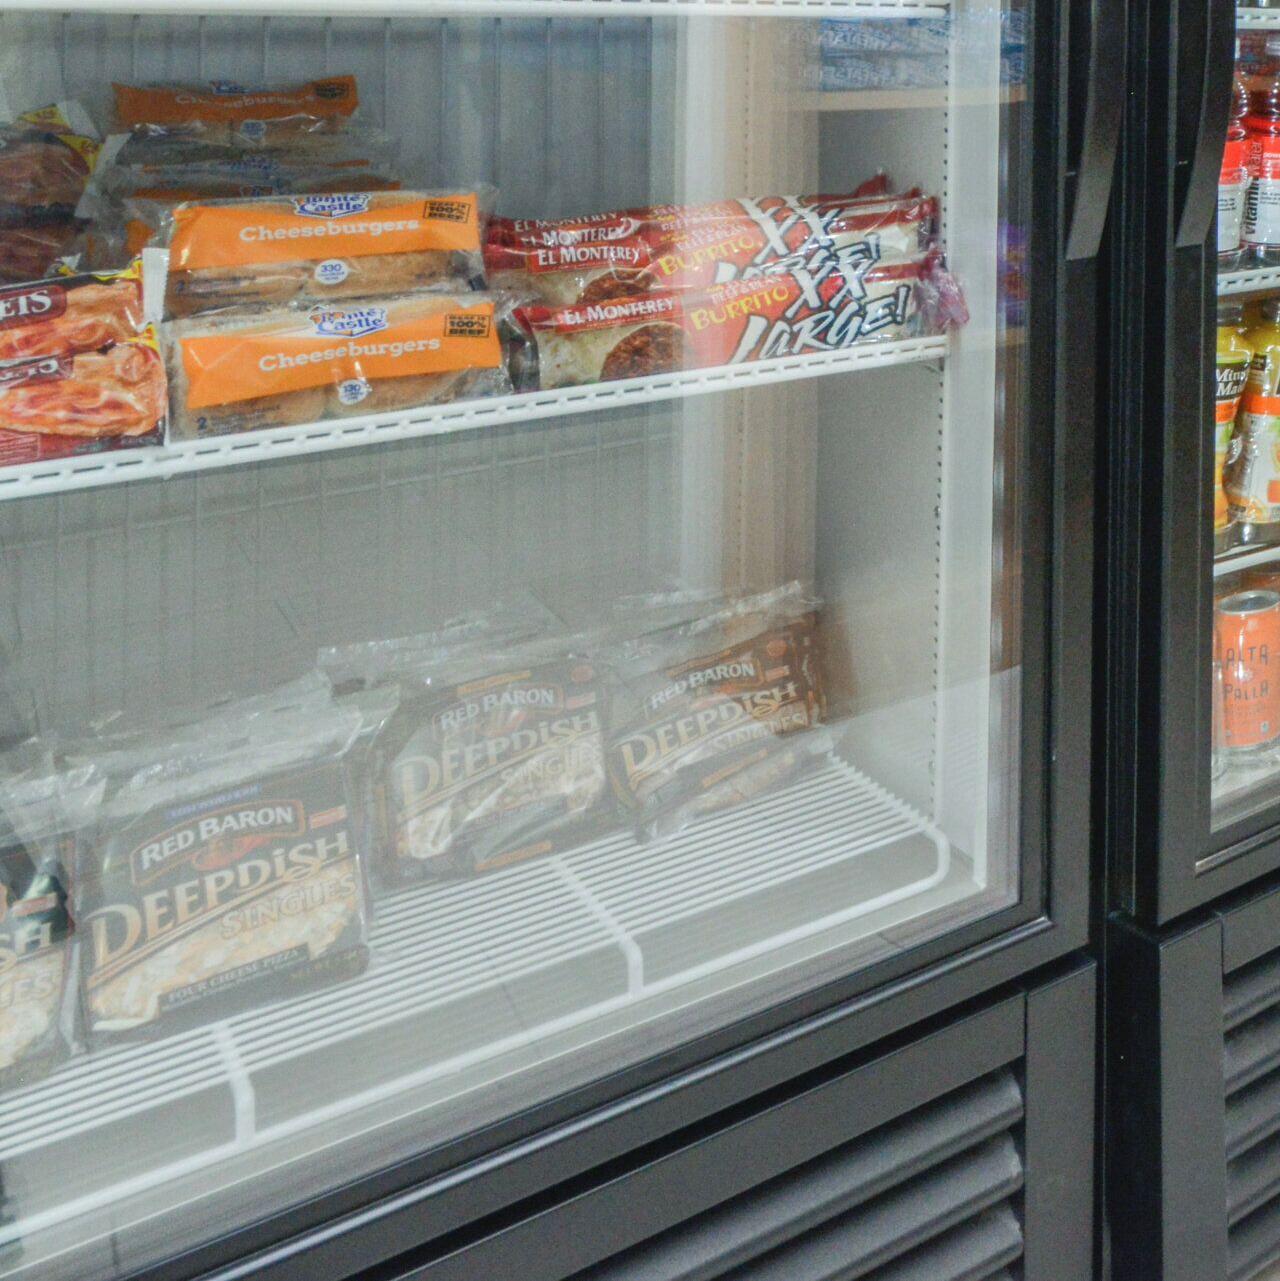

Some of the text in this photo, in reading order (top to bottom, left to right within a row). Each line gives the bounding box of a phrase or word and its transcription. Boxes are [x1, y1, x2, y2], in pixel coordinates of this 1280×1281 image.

[300, 201, 366, 213] Castle
[427, 204, 465, 215] 100%
[239, 219, 420, 242] Cheeseburgers
[320, 262, 342, 273] 330
[538, 244, 642, 266] EL MONTEREY
[658, 236, 756, 277] BURRITO
[564, 296, 674, 326] EL MONTEREY
[690, 285, 790, 331] BURRITO
[317, 317, 385, 332] Castle
[449, 319, 486, 329] 100%
[258, 338, 441, 372] Cheeseburgers
[1226, 643, 1270, 669] ALTA
[651, 661, 756, 711] RED BARON
[1223, 679, 1270, 702] PALLA
[440, 687, 555, 730] RED BARON
[140, 829, 195, 871] RED
[199, 805, 294, 842] BARON
[218, 872, 358, 941] SINGLES
[208, 962, 261, 990] CHEESE
